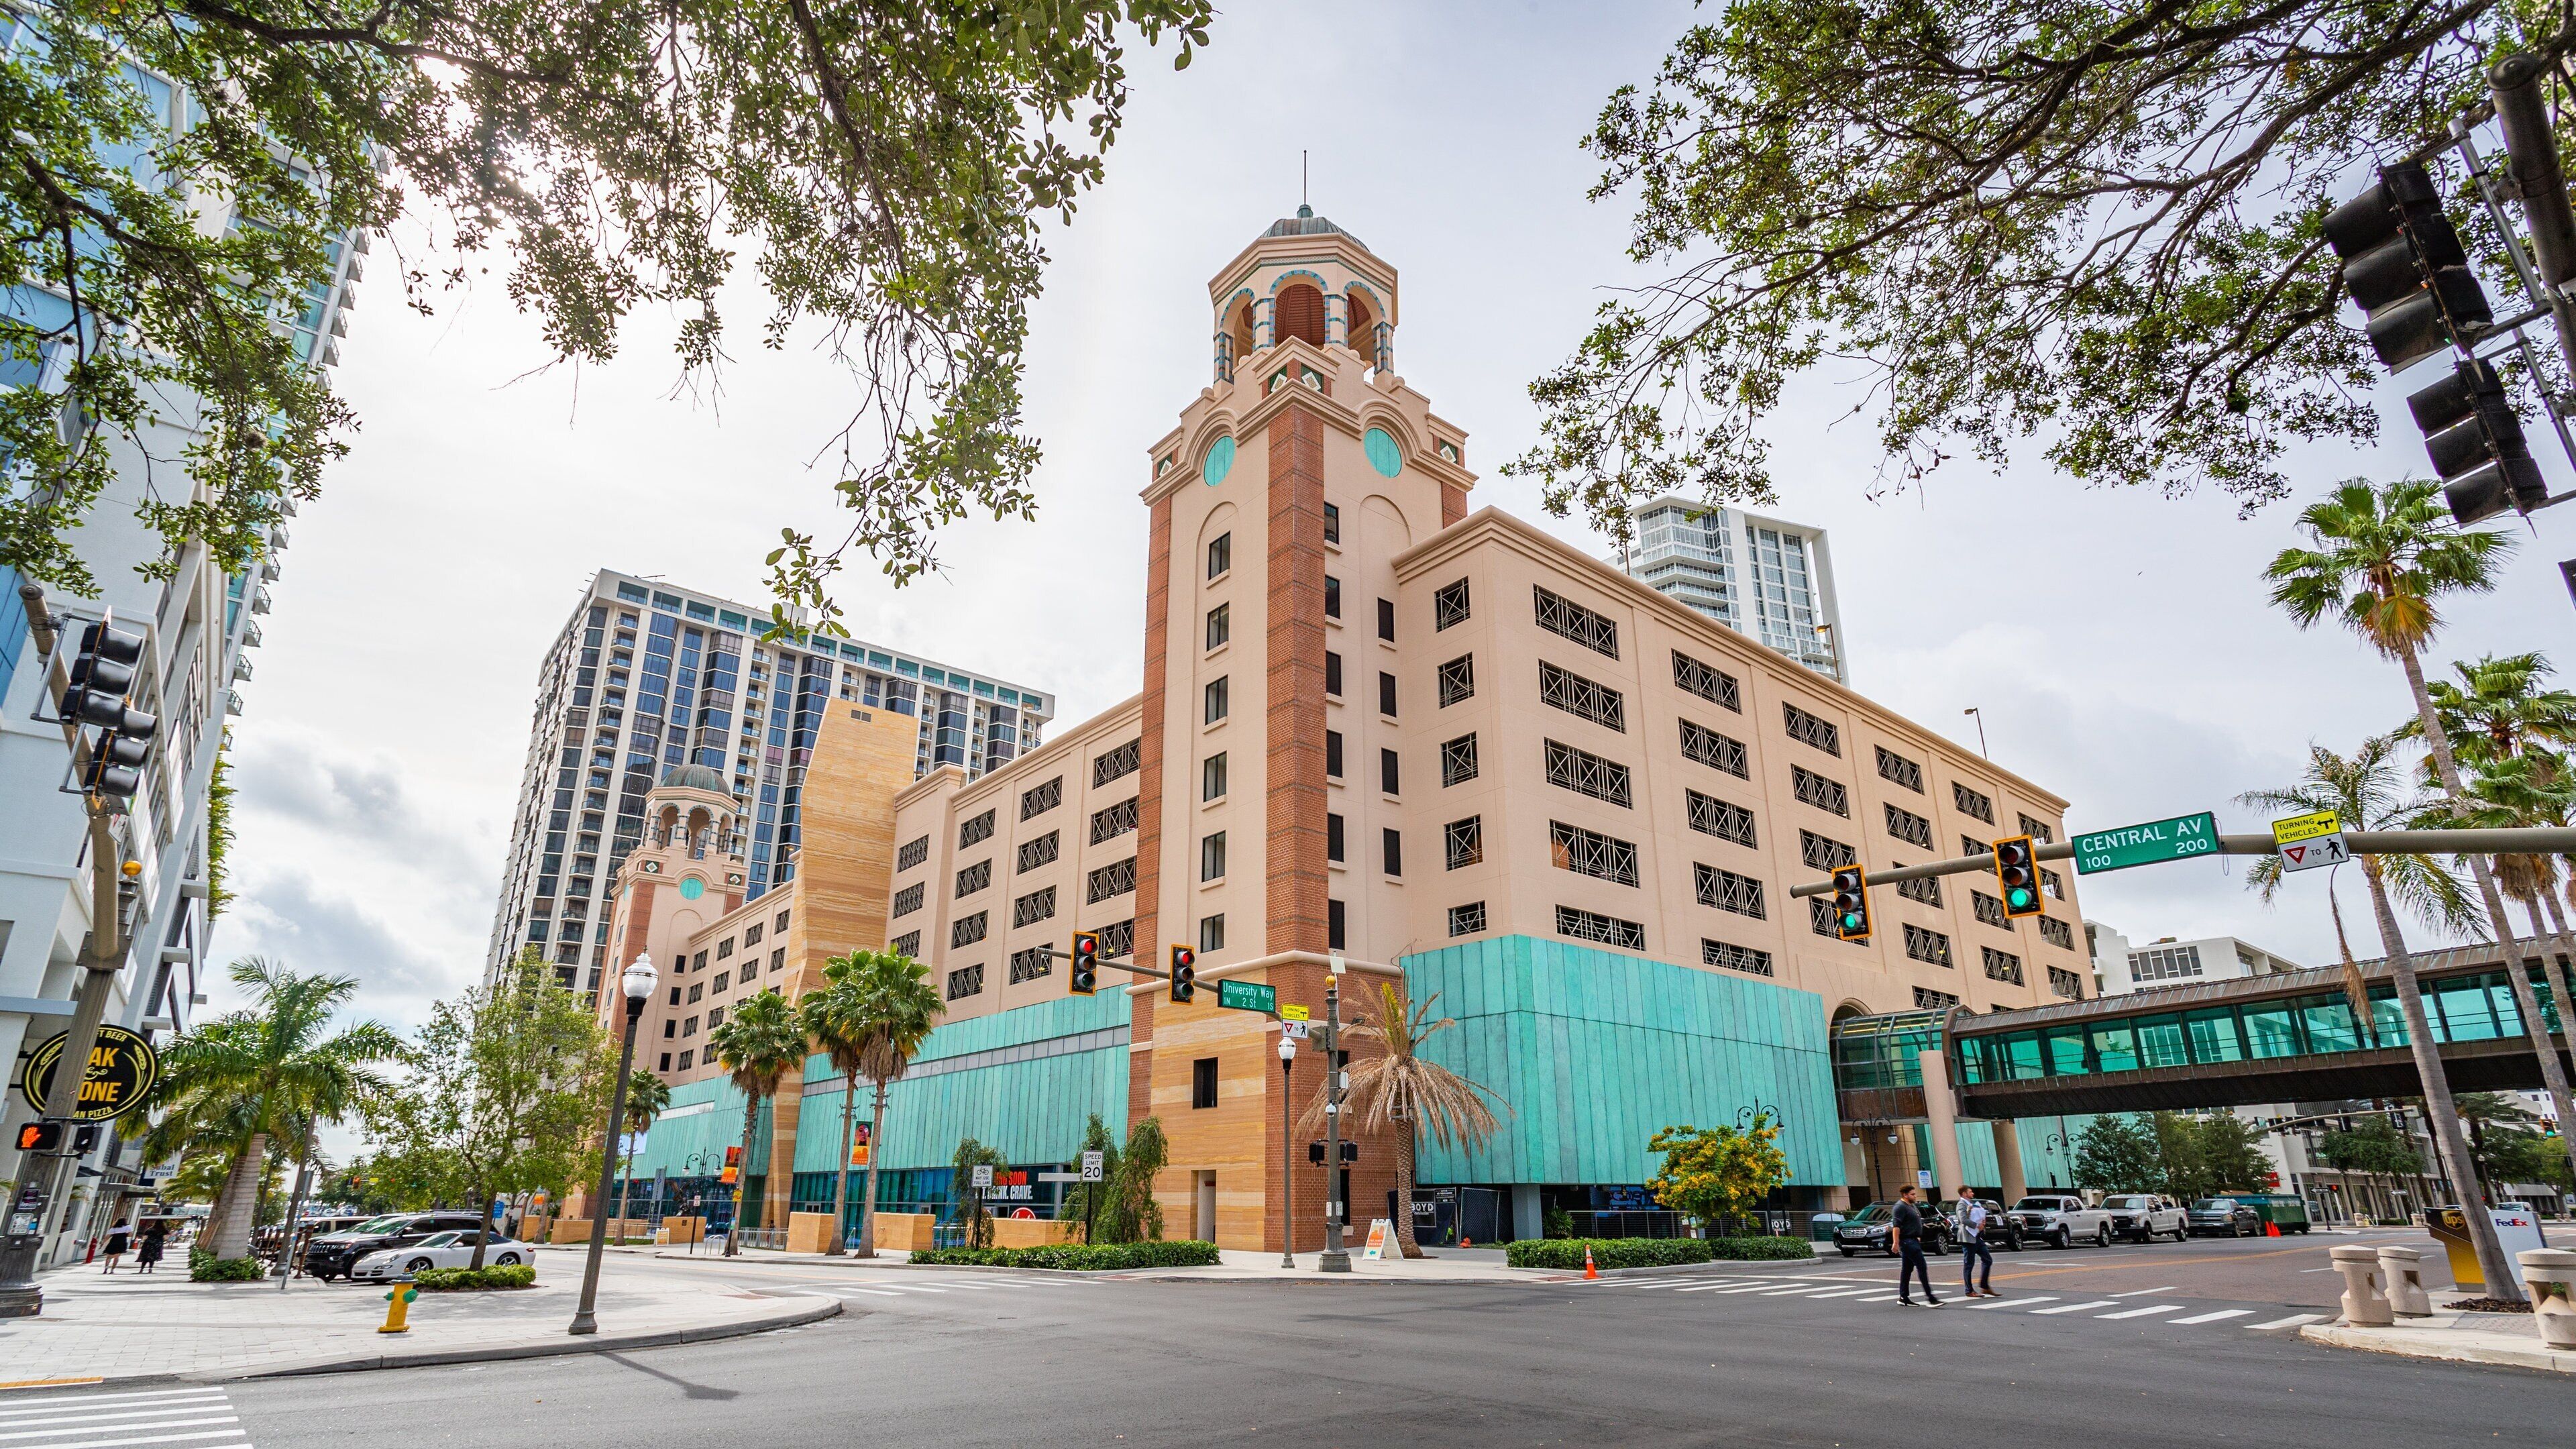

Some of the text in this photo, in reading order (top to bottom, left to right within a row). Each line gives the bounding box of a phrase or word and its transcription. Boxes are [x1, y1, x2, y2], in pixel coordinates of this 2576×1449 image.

[2278, 818, 2315, 830] TURNING
[2082, 818, 2202, 853] CENTRAL AV
[2279, 827, 2319, 840] VEHICLES
[2086, 838, 2208, 869] 100 200
[1223, 982, 1274, 1001] University Way
[1242, 998, 1246, 1007] 2
[1249, 998, 1256, 1008] St
[105, 1030, 127, 1042] BEER
[88, 1046, 119, 1067] AK
[78, 1081, 122, 1102] ONE
[88, 1106, 114, 1118] PIZZA
[1008, 1171, 1027, 1185] SOON
[1084, 1167, 1100, 1178] 20
[1010, 1185, 1033, 1199] CRAVE.
[2445, 1216, 2464, 1227] ups
[2495, 1218, 2528, 1227] FedEx
